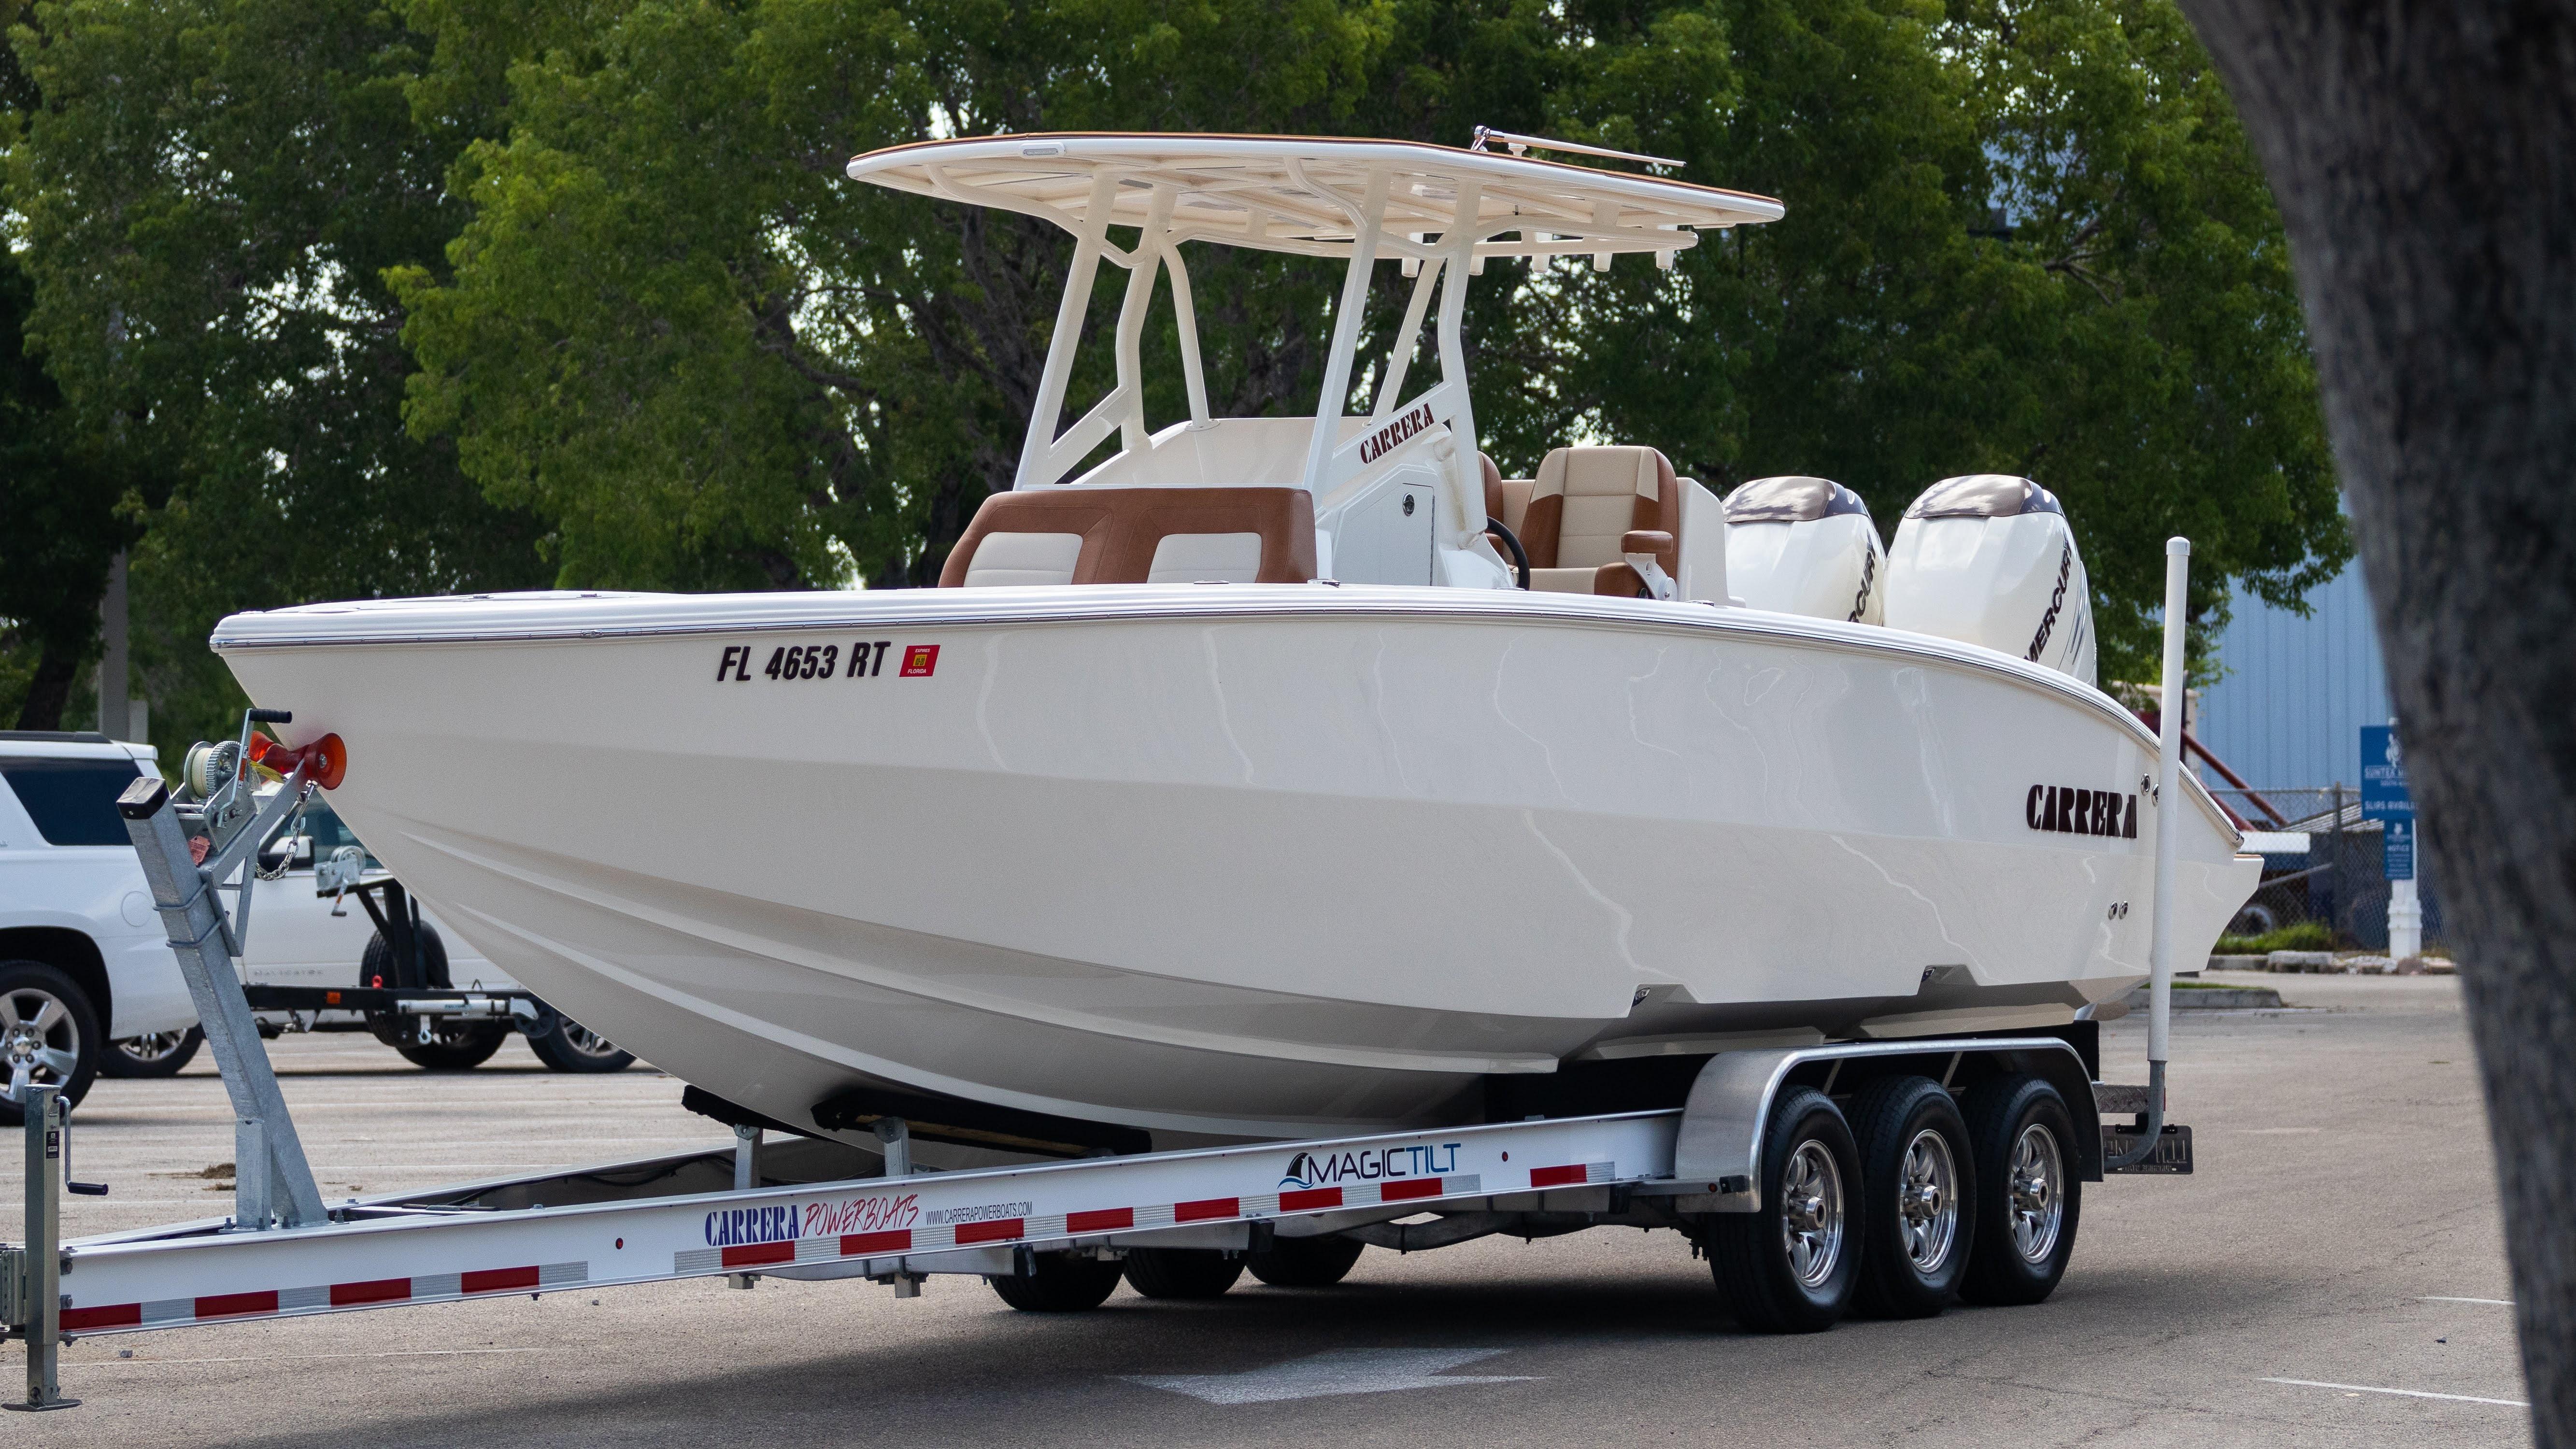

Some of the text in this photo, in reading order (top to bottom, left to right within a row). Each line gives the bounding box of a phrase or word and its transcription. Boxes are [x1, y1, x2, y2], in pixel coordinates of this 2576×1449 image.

[1360, 402, 1435, 464] CARRERA
[716, 641, 892, 682] FL 4653 RT
[2026, 784, 2137, 839] CARRERA
[1308, 1143, 1461, 1184] MAGICTILT
[705, 1193, 919, 1247] CARRERA POWERBOATS
[926, 1201, 1033, 1225] WWW.CARRERAPOWERBOATS.COM
